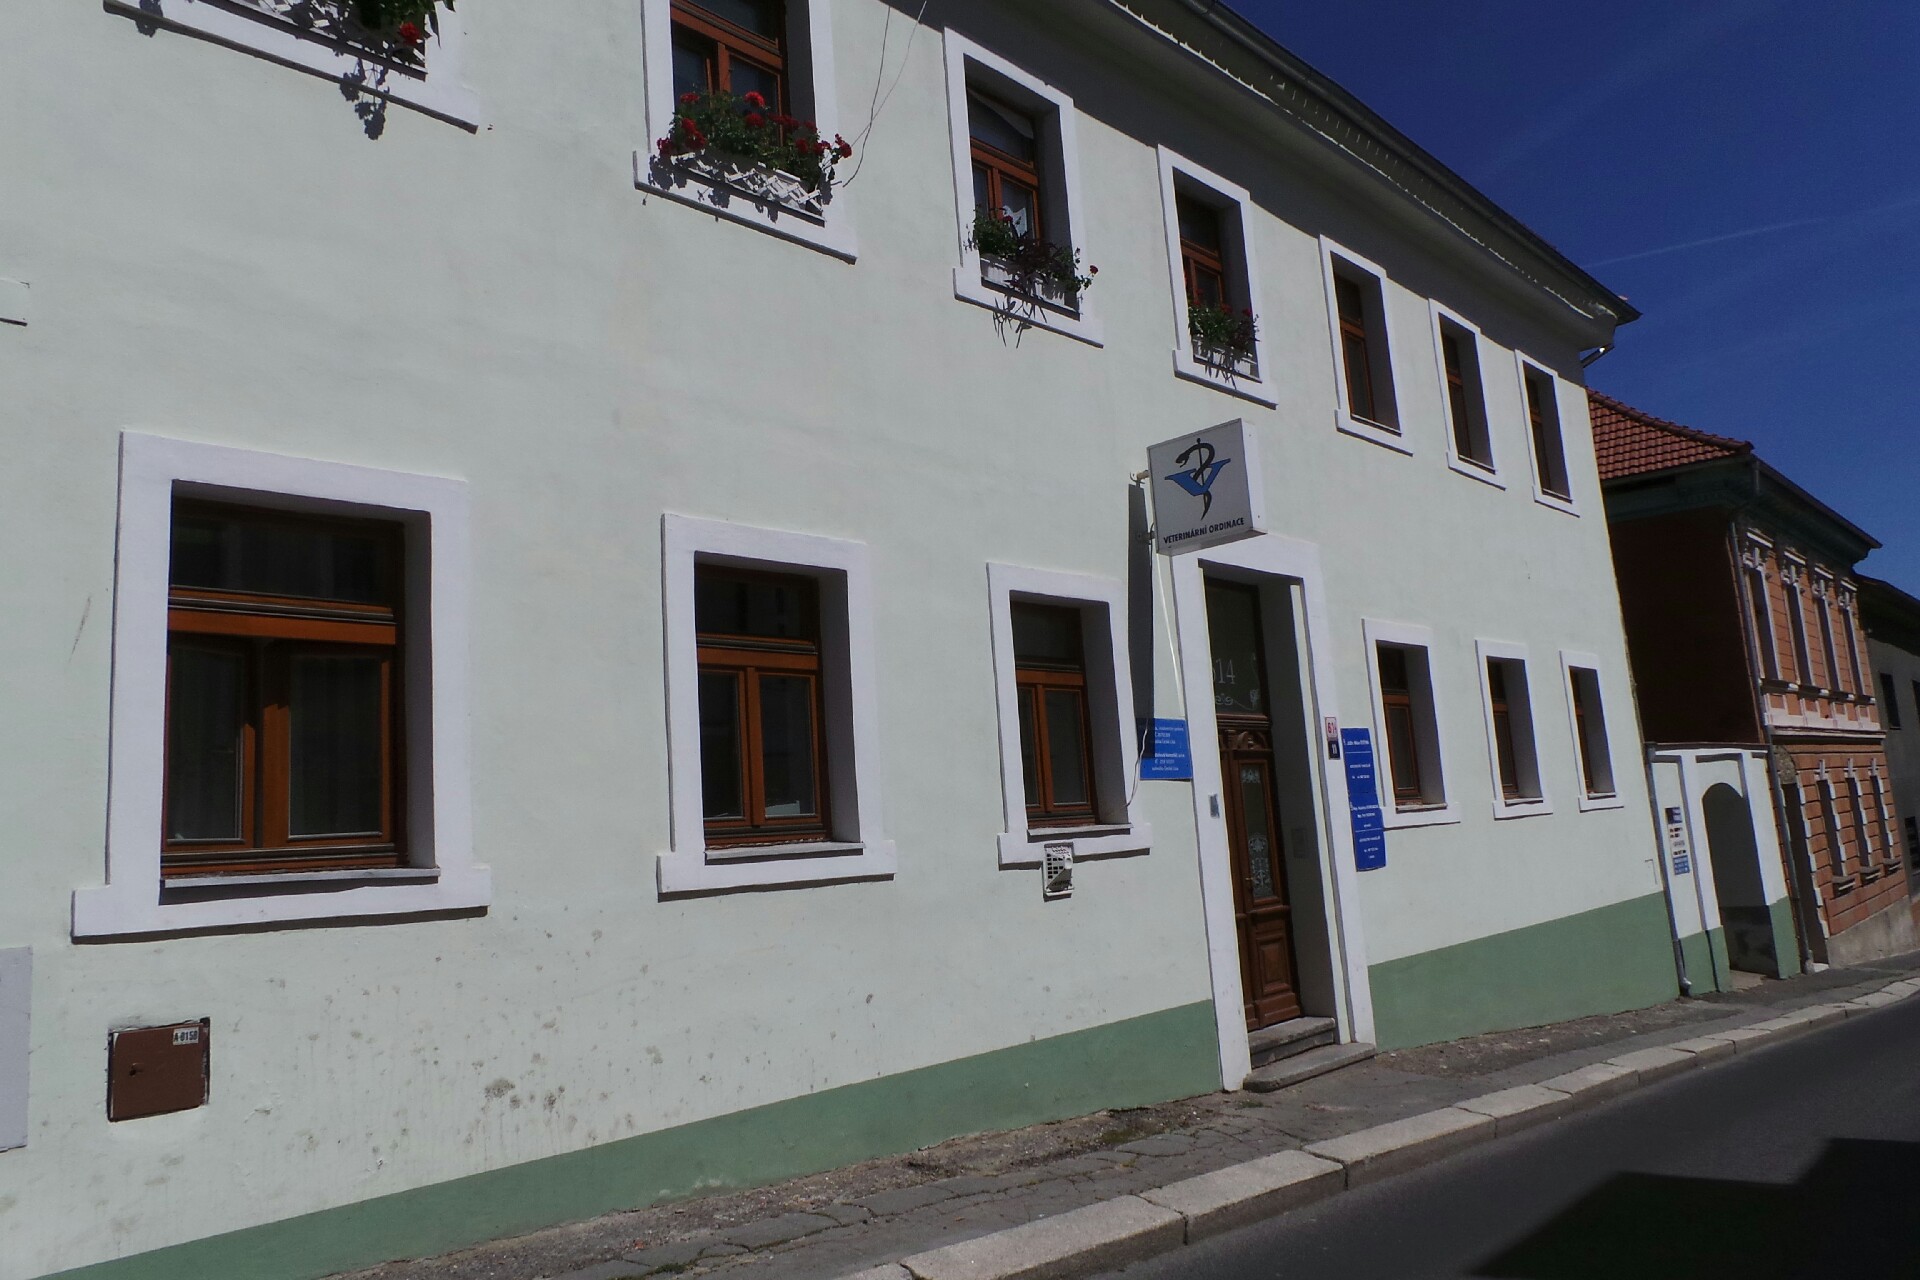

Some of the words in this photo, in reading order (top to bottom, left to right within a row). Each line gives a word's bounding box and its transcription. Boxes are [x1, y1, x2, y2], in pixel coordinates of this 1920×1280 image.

[1163, 525, 1208, 544] VETERINÁRNÍ
[1208, 517, 1245, 533] ORDINACE
[1212, 658, 1236, 684] 14
